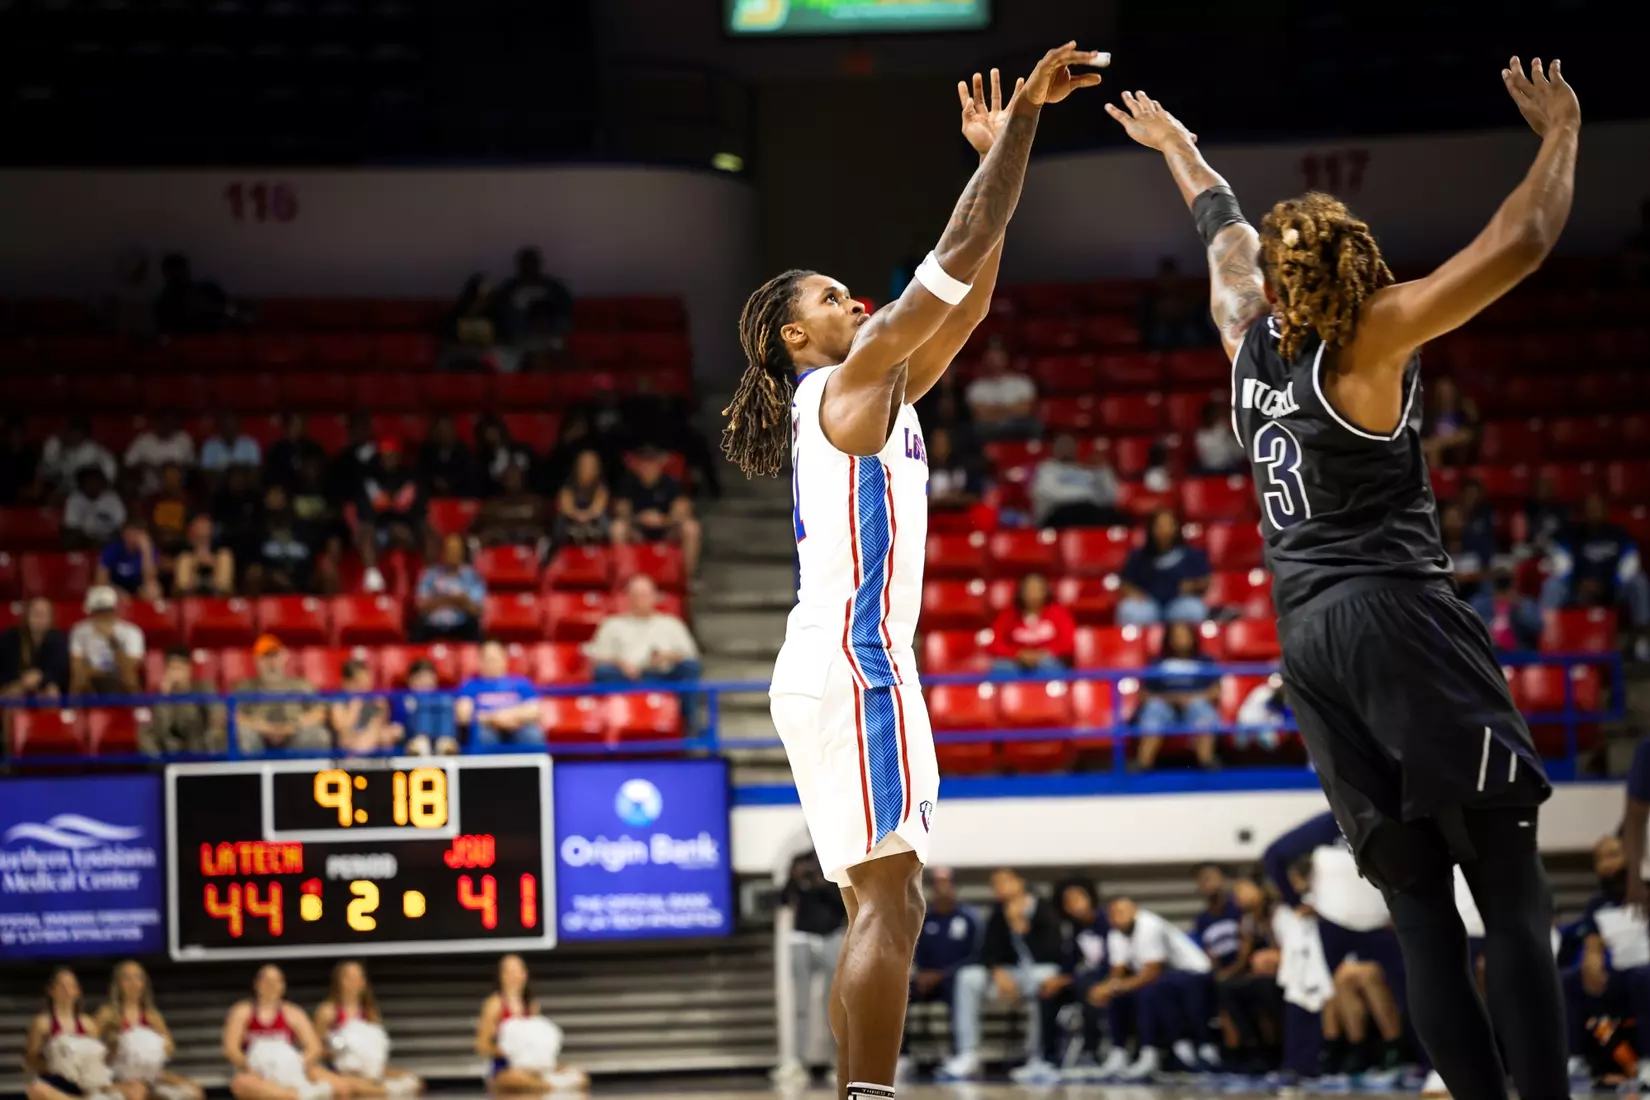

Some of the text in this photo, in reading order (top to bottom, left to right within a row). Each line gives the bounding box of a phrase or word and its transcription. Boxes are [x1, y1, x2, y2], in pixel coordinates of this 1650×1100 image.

[1299, 149, 1370, 192] 117
[221, 181, 299, 222] 116
[1253, 420, 1311, 530] 3
[314, 769, 448, 829] 9:18
[561, 831, 720, 872] Origin Bank
[204, 882, 283, 938] 44
[347, 880, 380, 931] 2
[457, 873, 537, 929] 41
